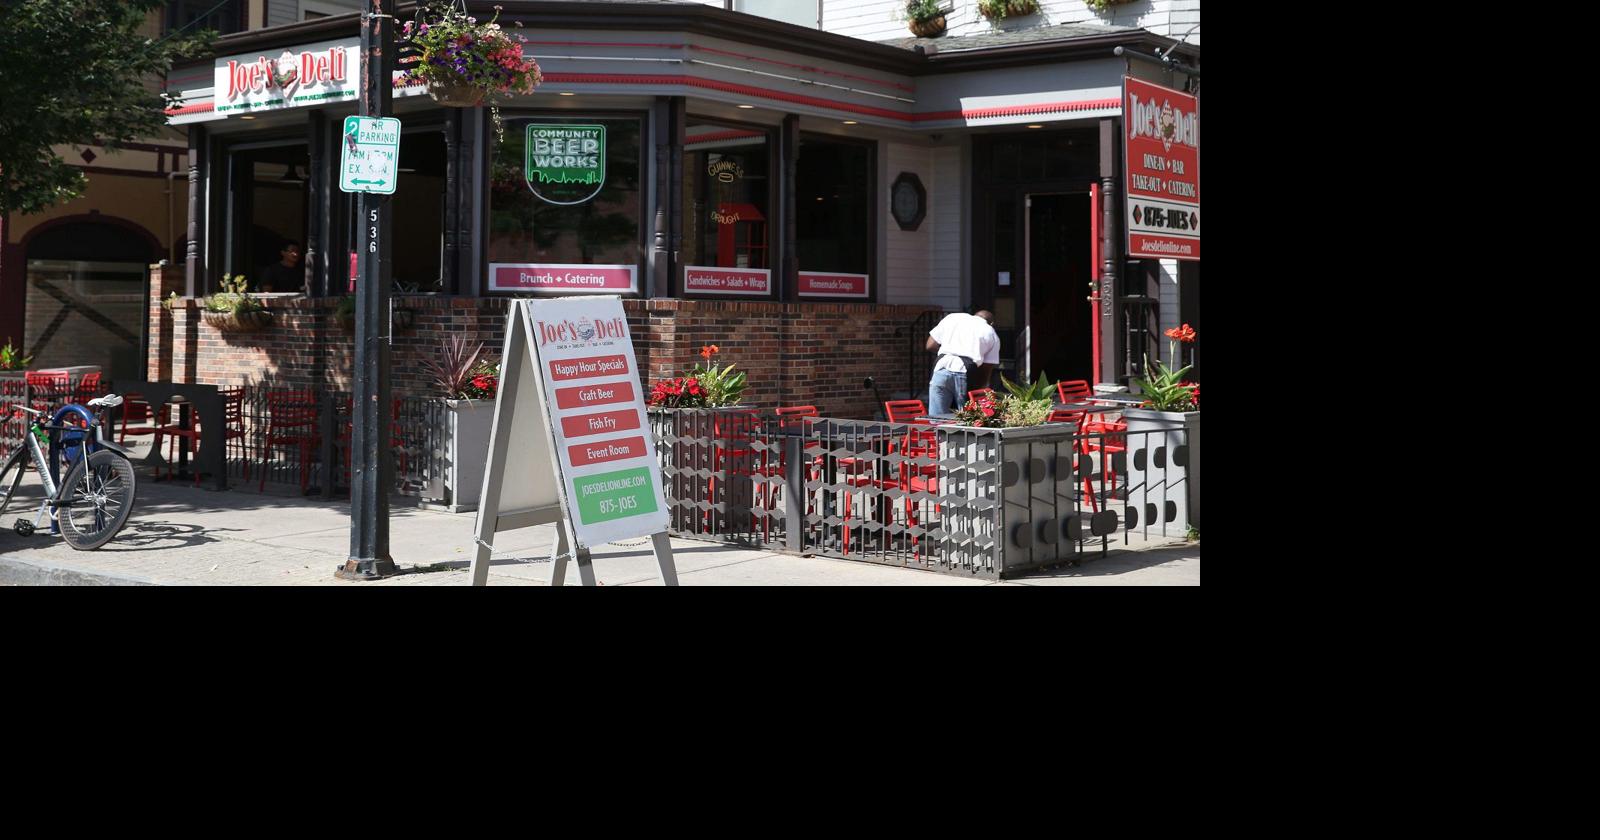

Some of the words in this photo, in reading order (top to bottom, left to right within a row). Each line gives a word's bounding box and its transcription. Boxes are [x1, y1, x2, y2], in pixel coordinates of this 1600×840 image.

[227, 56, 274, 99] Joe's
[300, 46, 347, 86] Deli
[1129, 92, 1161, 140] Joe's
[1174, 107, 1198, 147] Deli
[360, 131, 395, 143] PARKING
[533, 129, 598, 138] COMMUNITY
[533, 138, 599, 155] BEER
[533, 155, 599, 168] WORKS
[708, 160, 744, 178] GUINNESS
[1143, 153, 1165, 171] DINE-IN
[1172, 159, 1184, 174] BAR
[1132, 173, 1161, 192] TAKE-OUT
[1168, 179, 1196, 197] CATERING
[711, 210, 740, 225] DRAUGHT
[1143, 206, 1189, 230] 875-JOES
[520, 272, 554, 284] Brunch
[564, 273, 605, 287] Catering
[688, 274, 721, 287] Sandwiches
[726, 275, 744, 288] Salads
[749, 277, 766, 290] Wraps
[809, 279, 838, 290] Homemade
[838, 280, 854, 292] Soups
[536, 319, 578, 346] Joe's
[594, 316, 626, 340] Deli
[554, 363, 579, 377] Happy
[579, 361, 598, 373] Hour
[598, 358, 625, 374] Specials
[578, 389, 599, 402] Craft
[597, 387, 615, 400] Beer
[588, 418, 605, 430] Fish
[604, 416, 617, 429] Fry
[586, 447, 610, 460] Event
[608, 445, 631, 456] Room
[581, 475, 647, 498] JOESDELIONLINE.COM
